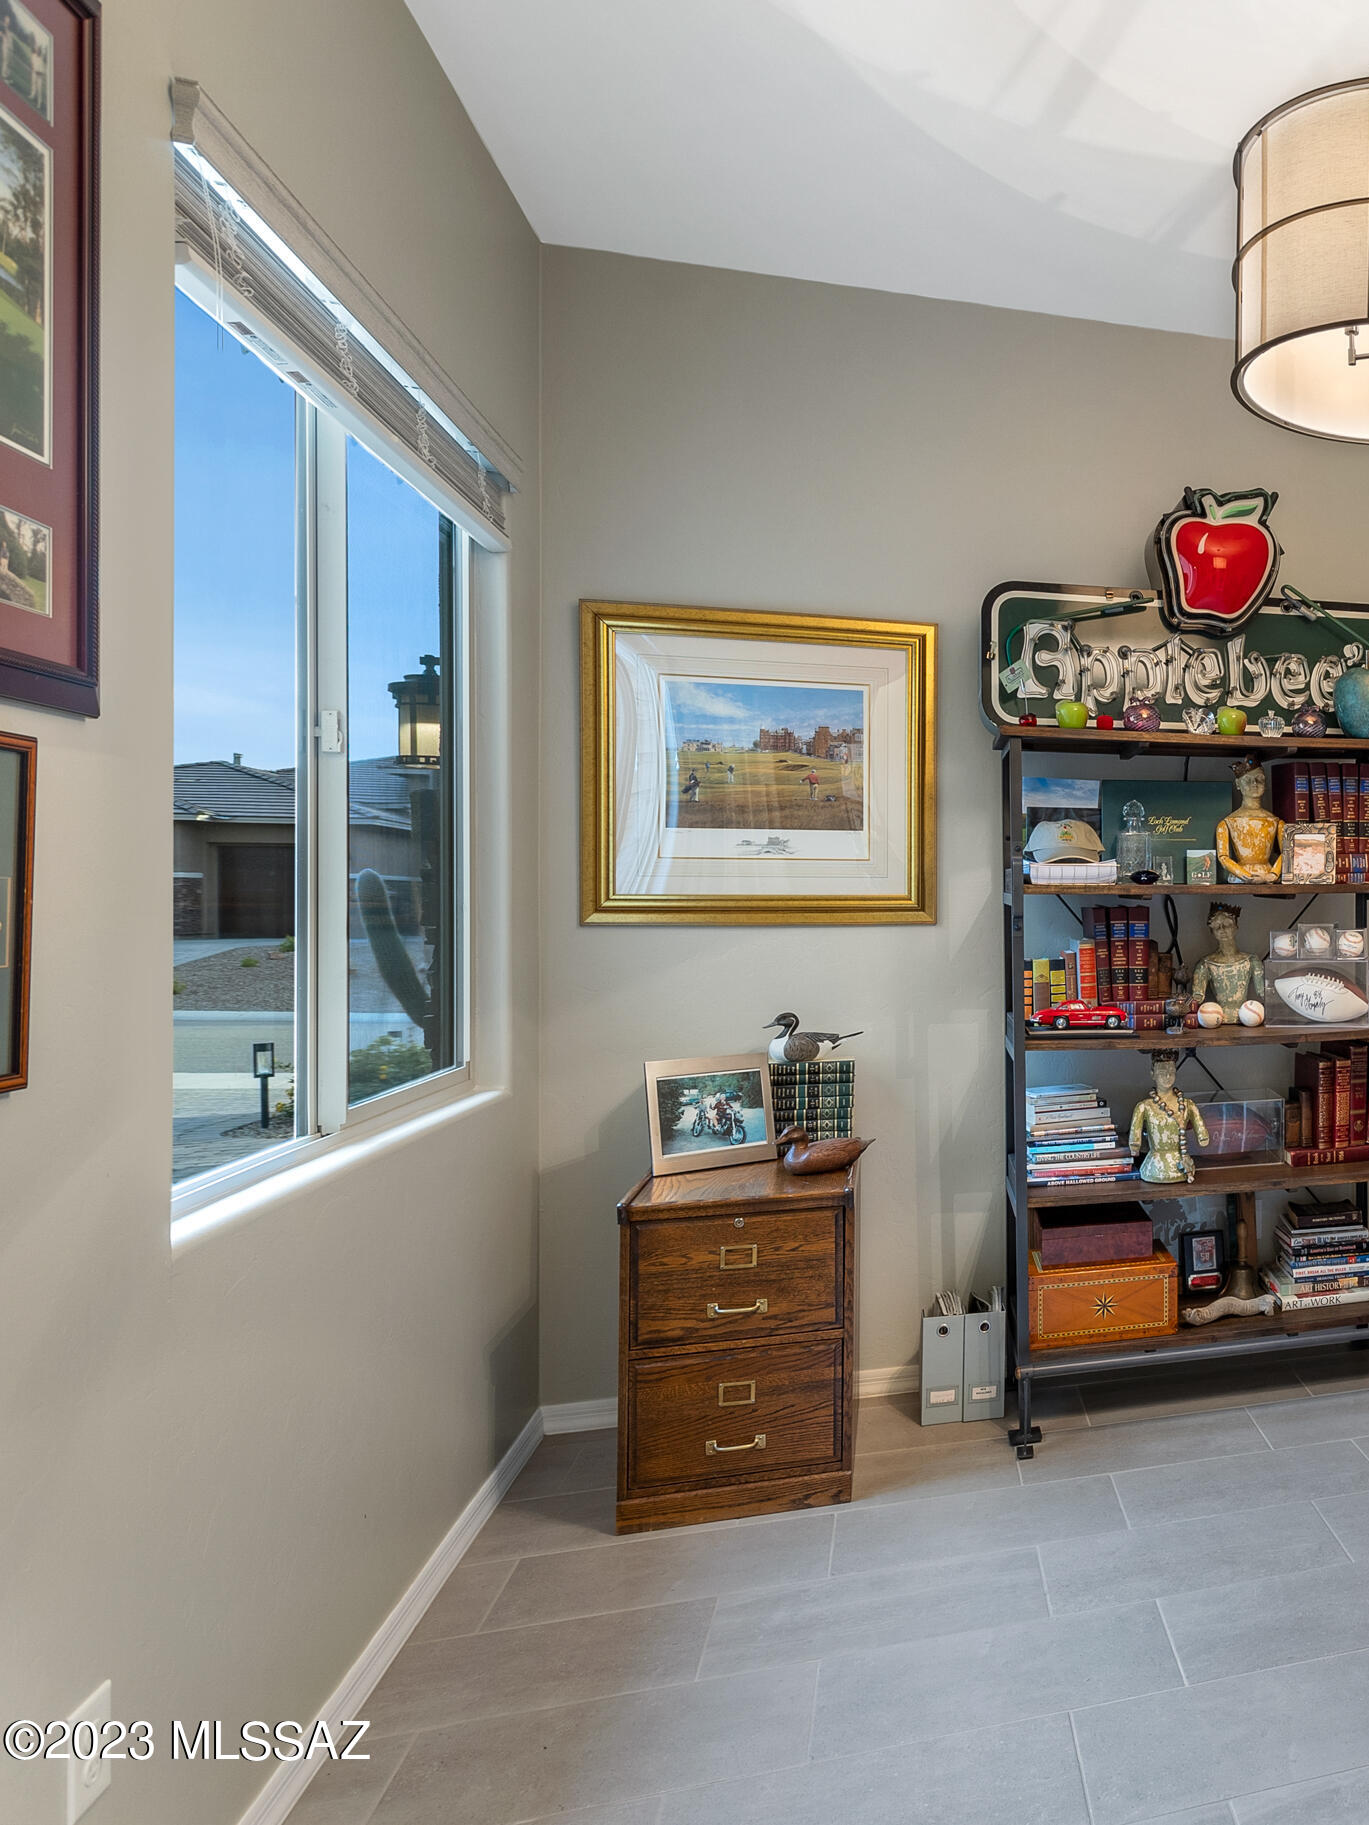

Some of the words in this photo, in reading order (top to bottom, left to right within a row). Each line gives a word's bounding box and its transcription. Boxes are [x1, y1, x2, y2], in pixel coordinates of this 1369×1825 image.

[1018, 620, 1366, 717] Applebee'
[1299, 1284, 1314, 1292] ART
[1314, 1281, 1343, 1291] HISTORY
[1285, 1300, 1304, 1310] ART
[1311, 1296, 1342, 1306] WORK
